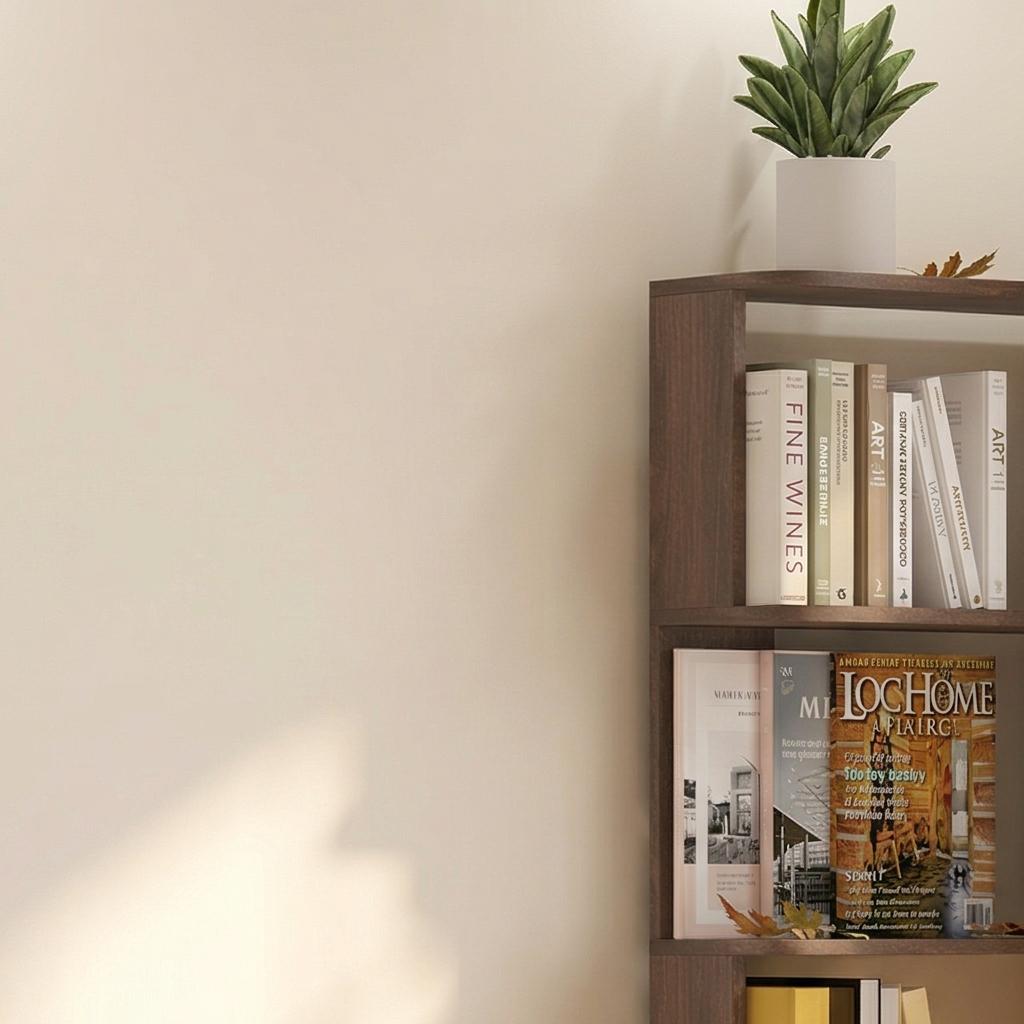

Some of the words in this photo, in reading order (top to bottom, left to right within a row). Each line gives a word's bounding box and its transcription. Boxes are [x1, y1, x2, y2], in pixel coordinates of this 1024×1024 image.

[785, 403, 803, 466] FINE
[871, 421, 885, 460] ART
[991, 428, 1005, 465] ART
[785, 479, 804, 573] WINES
